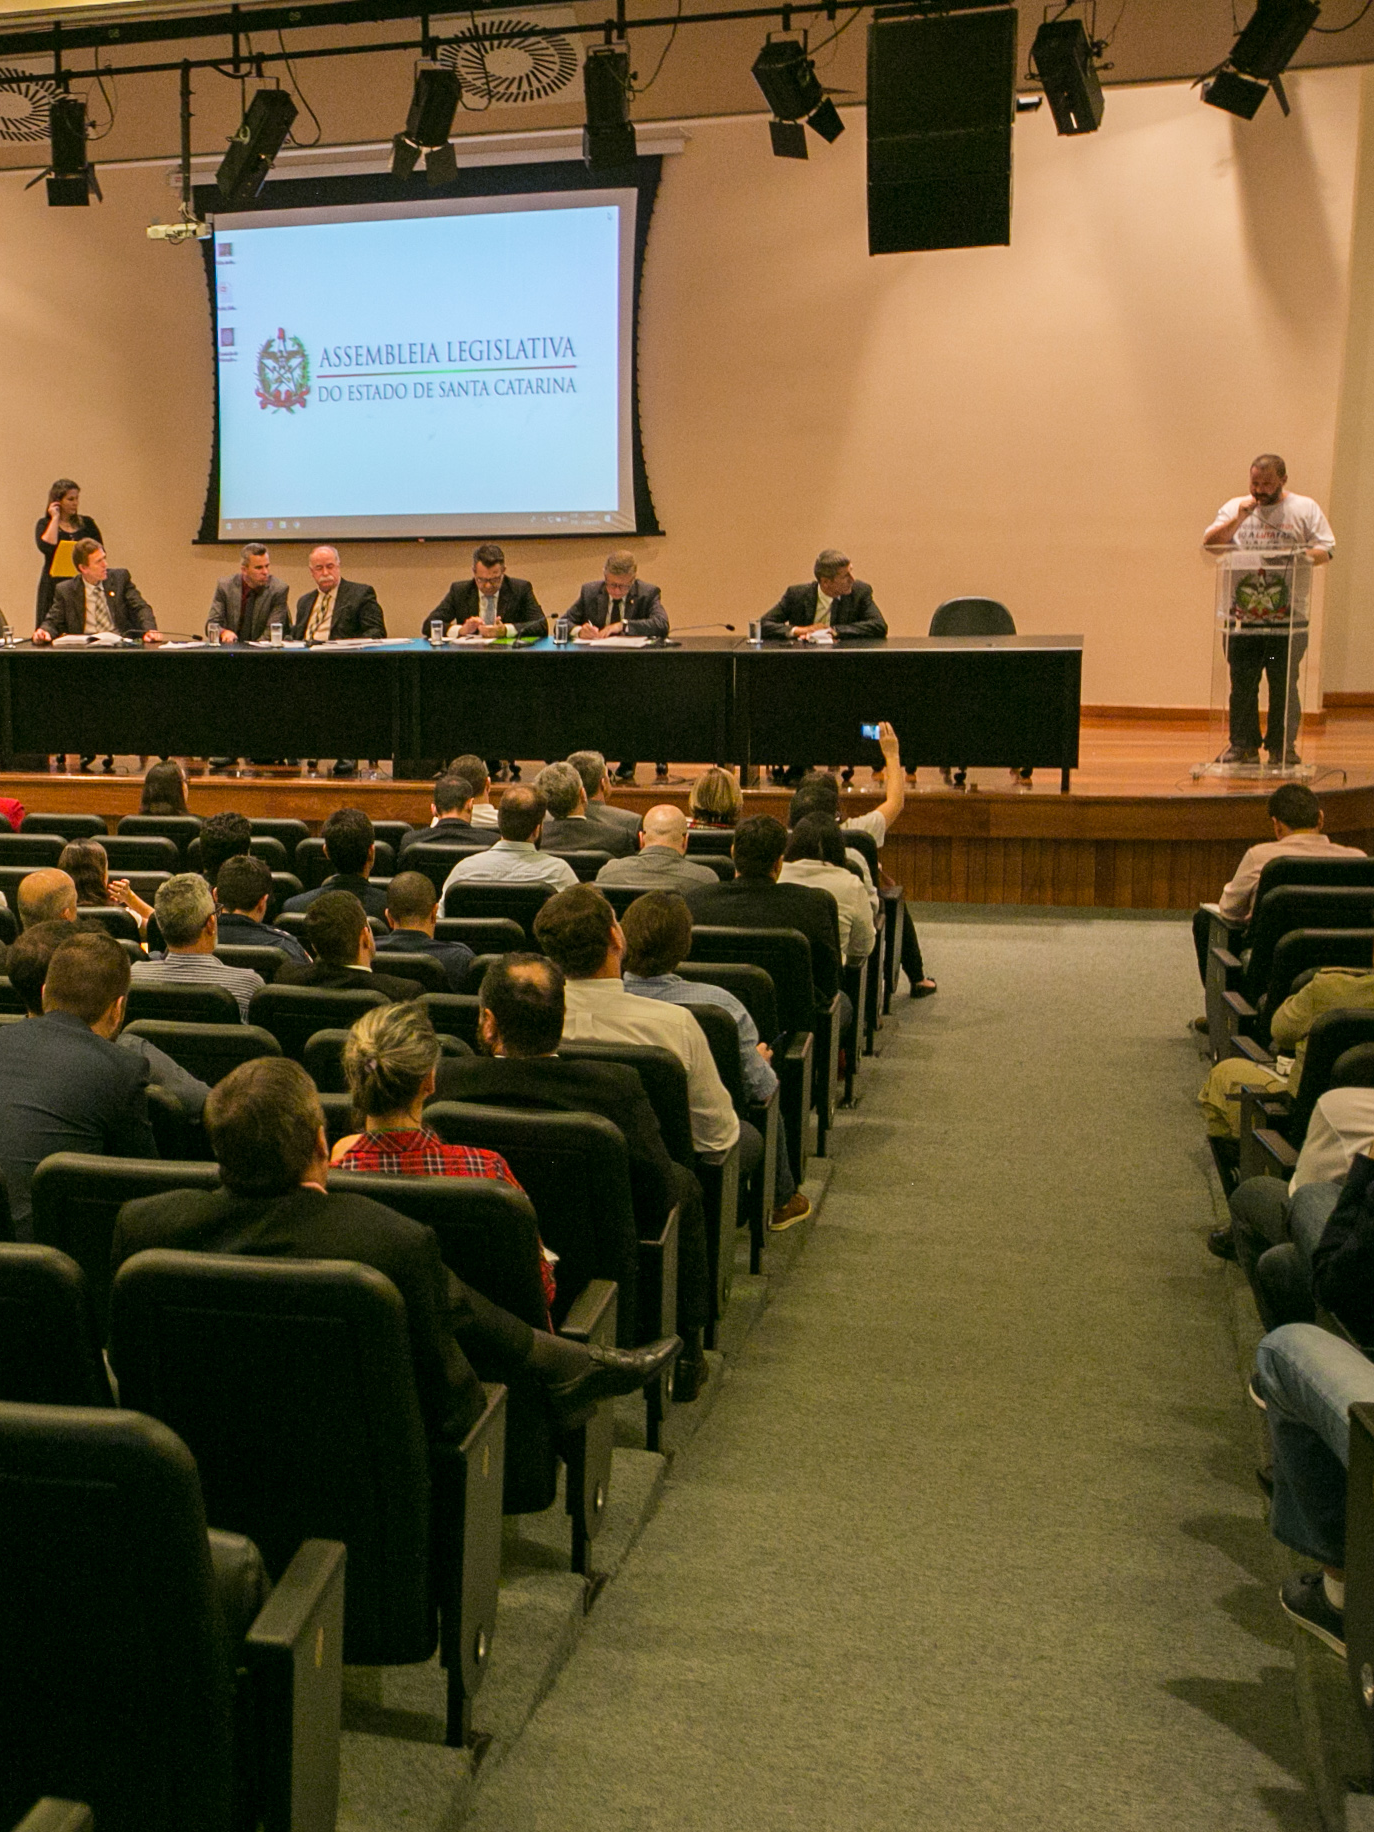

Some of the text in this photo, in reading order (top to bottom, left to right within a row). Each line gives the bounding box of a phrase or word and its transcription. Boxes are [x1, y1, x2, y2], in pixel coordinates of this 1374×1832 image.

[319, 336, 577, 368] ASSEMBLEIA LEGISLATIVA
[317, 376, 577, 403] DO ESTADO DE SANTA CATARINA
